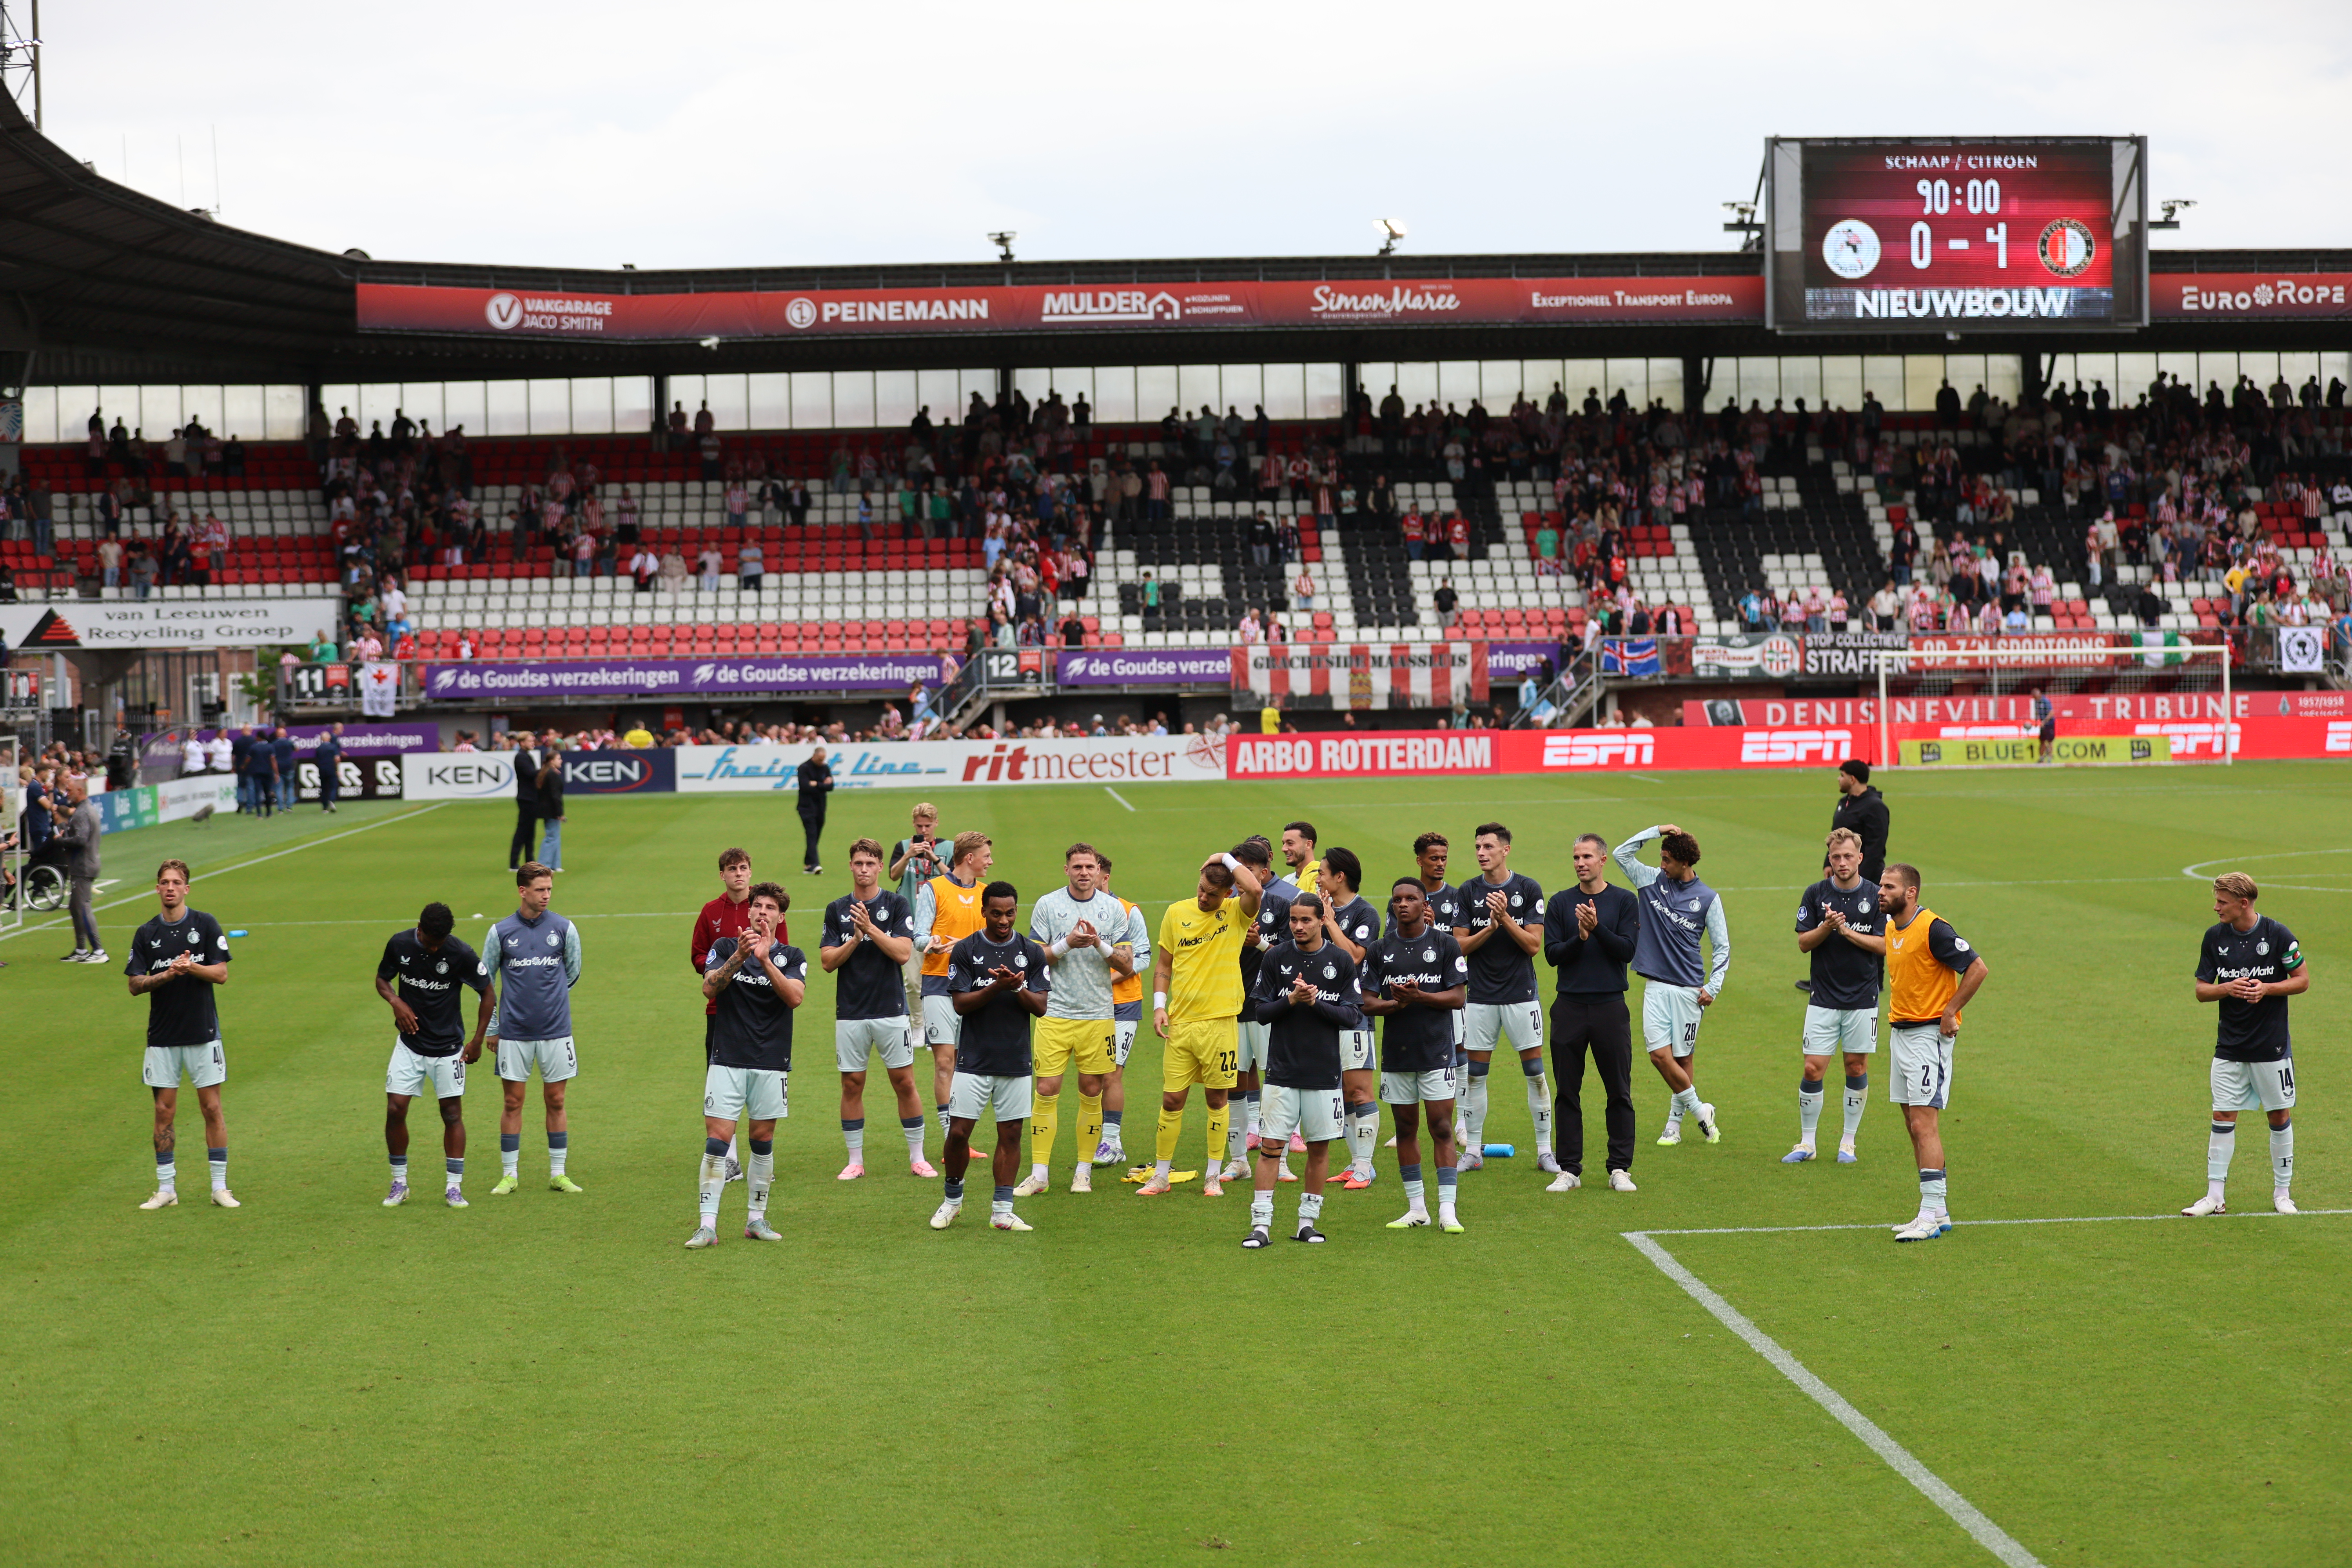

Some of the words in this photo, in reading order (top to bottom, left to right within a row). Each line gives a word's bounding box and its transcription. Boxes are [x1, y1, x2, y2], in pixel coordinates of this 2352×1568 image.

[1885, 155, 1950, 169] SCHAAP
[1955, 153, 1962, 171] /
[1967, 155, 2038, 169] CITROEN
[1916, 178, 2000, 215] 90:00
[1910, 220, 1932, 269] 0
[1985, 222, 2007, 269] 4
[524, 298, 612, 316] VAKGARAGE
[822, 298, 989, 323] PEINEMANN
[1042, 290, 1147, 314] MULDER
[1855, 289, 2071, 318] NIEUWBOUW
[522, 313, 557, 329] JACO
[559, 315, 603, 331] SMITH
[105, 609, 144, 621] van
[156, 606, 269, 621] Leeuwen
[88, 626, 204, 642] Recycling
[216, 624, 294, 639] Groep
[1805, 634, 1834, 647] STOP
[1836, 634, 1907, 648] COLLECTIEVE
[987, 653, 1017, 678] 12
[1088, 659, 1111, 677] de
[1112, 657, 1177, 676] Goudse
[1254, 653, 1367, 669] GRACHTSIDE
[1371, 653, 1467, 668] MAASSLUIS
[1805, 649, 1907, 675] STRAFFEN
[296, 668, 324, 692] 11
[353, 668, 365, 691] 1
[457, 670, 481, 689] de
[483, 668, 550, 688] Goudse
[550, 667, 679, 689] verzekeringen
[716, 664, 739, 684] de
[741, 663, 808, 683] Goudse
[809, 662, 938, 684] verzekeringen
[1766, 700, 1875, 726] DENIS
[2089, 694, 2250, 720] TRIBUNE
[1235, 739, 1313, 773] ARBO
[1321, 736, 1492, 771] ROTTERDAM
[1542, 733, 1655, 767] ESPN
[1740, 729, 1852, 763] ESPN
[564, 760, 641, 783] KEN
[962, 744, 1176, 782] ritmeester
[429, 765, 500, 785] KEN
[299, 788, 322, 799] ROBE
[338, 786, 363, 797] ROBEY
[376, 784, 401, 796] ROBEY
[1472, 918, 1491, 927] Medi
[509, 958, 532, 967] Media
[539, 956, 560, 965] Markt
[2217, 965, 2240, 978] Media
[2249, 965, 2274, 977] Markt
[733, 971, 757, 984] Media
[1414, 973, 1441, 984] Markt
[1122, 1031, 1133, 1051] 32
[1684, 1022, 1697, 1041] 28
[566, 1041, 573, 1061] 5
[1105, 1034, 1116, 1056] 39
[1354, 1032, 1361, 1052] 9
[1220, 1050, 1238, 1072] 22
[1922, 1064, 1930, 1086] 2
[2278, 1067, 2294, 1091] 14
[1847, 1096, 1862, 1107] F
[1537, 1109, 1551, 1121] F
[1031, 1125, 1048, 1136] F
[1086, 1124, 1102, 1135] F
[1357, 1128, 1373, 1138] F
[2280, 1156, 2293, 1167] F
[755, 1190, 768, 1201] F
